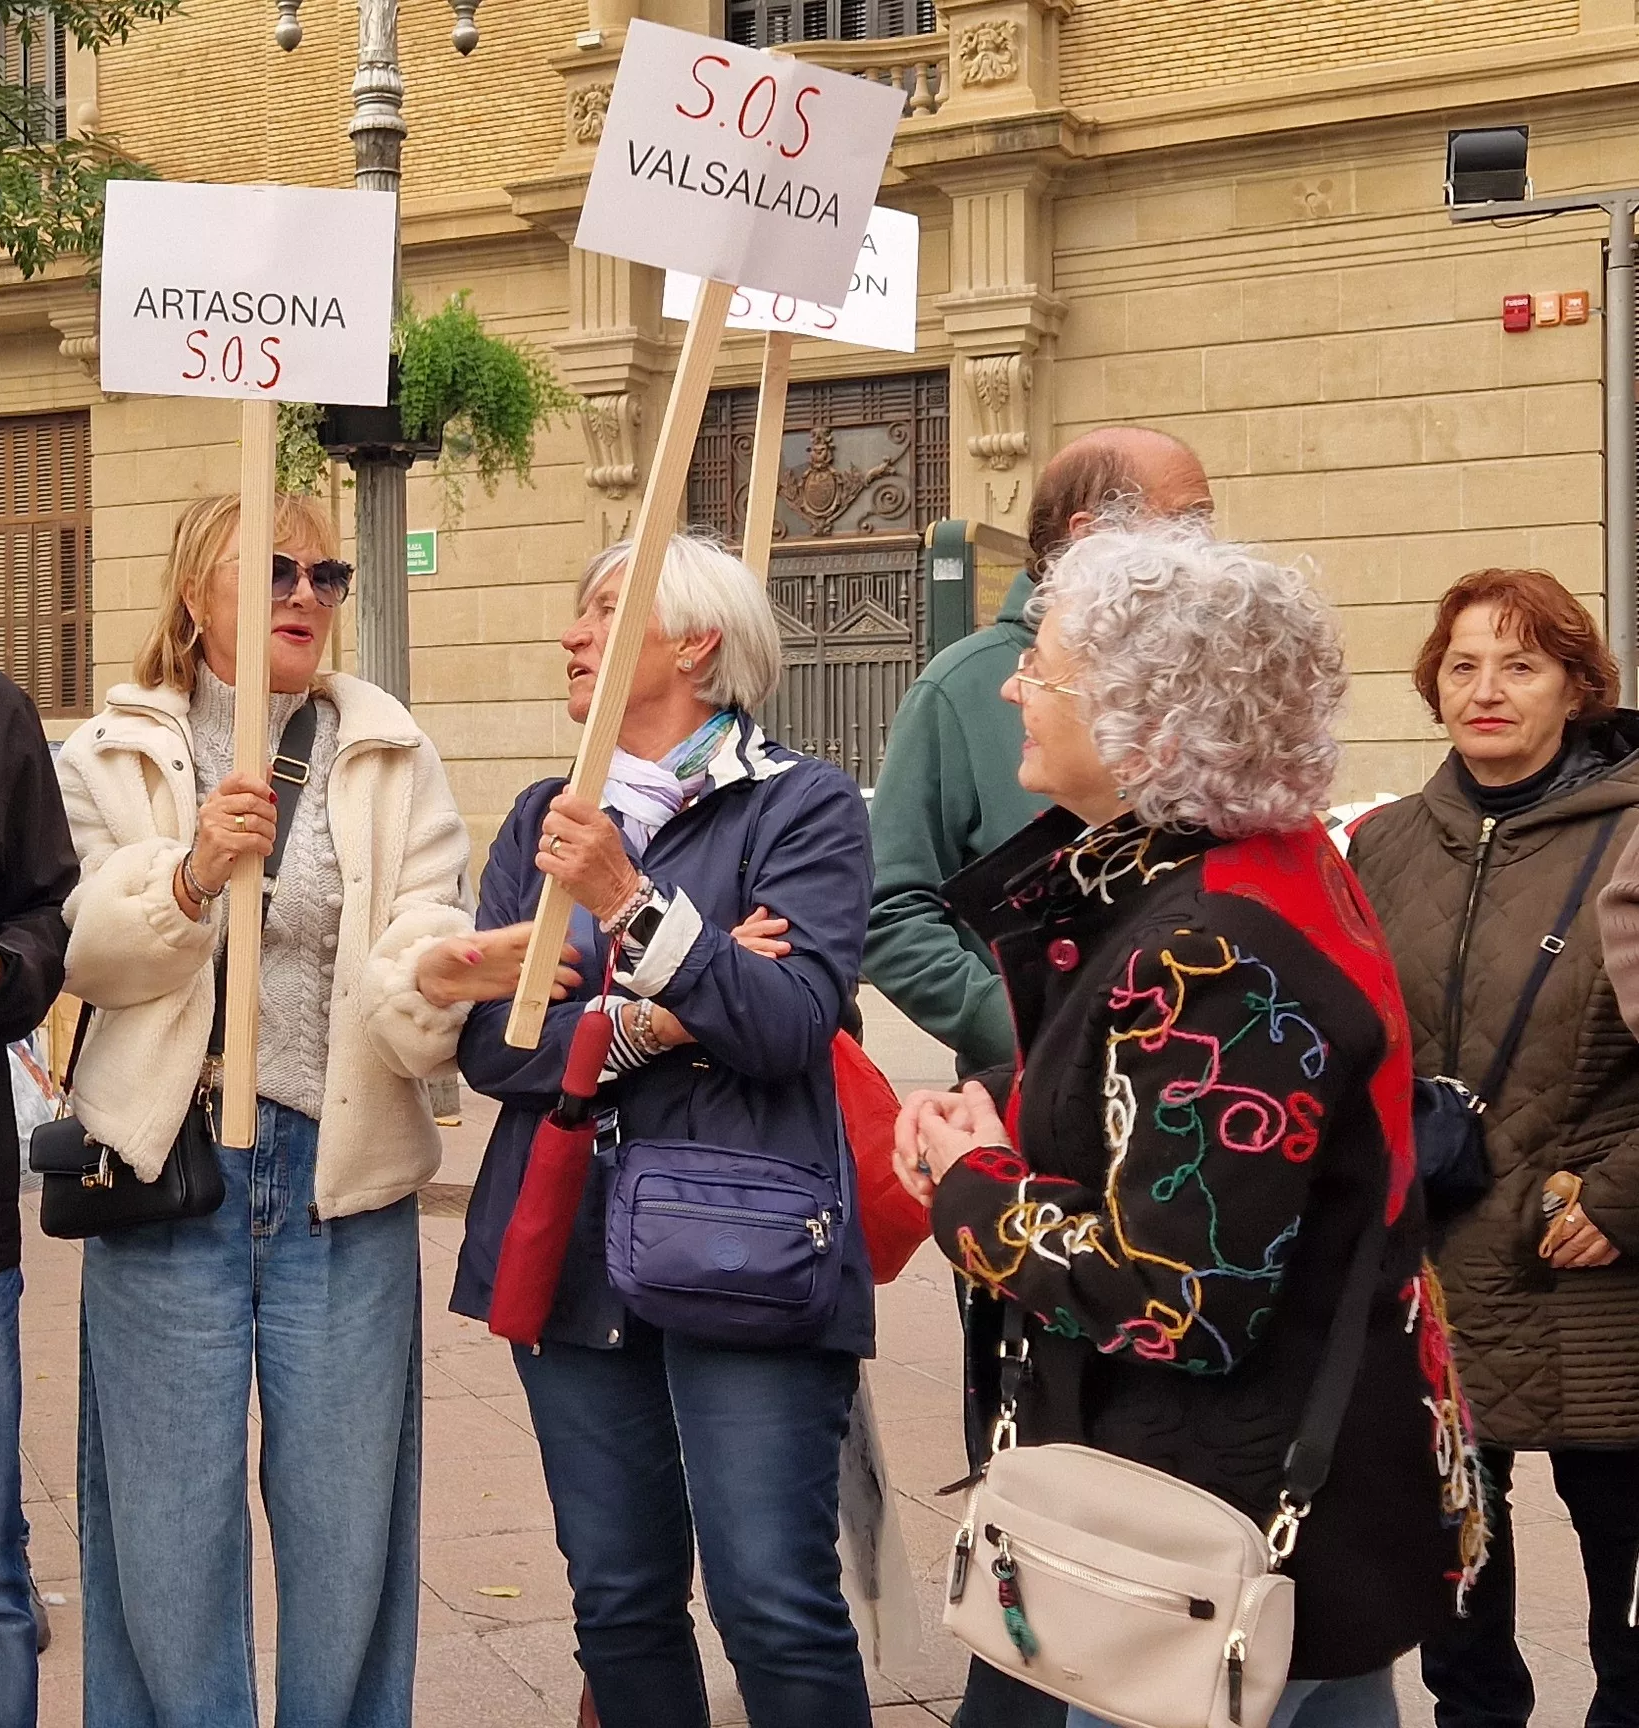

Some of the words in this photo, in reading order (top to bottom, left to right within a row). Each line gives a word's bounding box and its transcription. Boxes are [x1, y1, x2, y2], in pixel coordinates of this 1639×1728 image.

[674, 54, 822, 160] S.O.S
[628, 140, 841, 228] VALSALADA
[133, 287, 347, 329] ARTASONA
[181, 329, 283, 390] S.O.S
